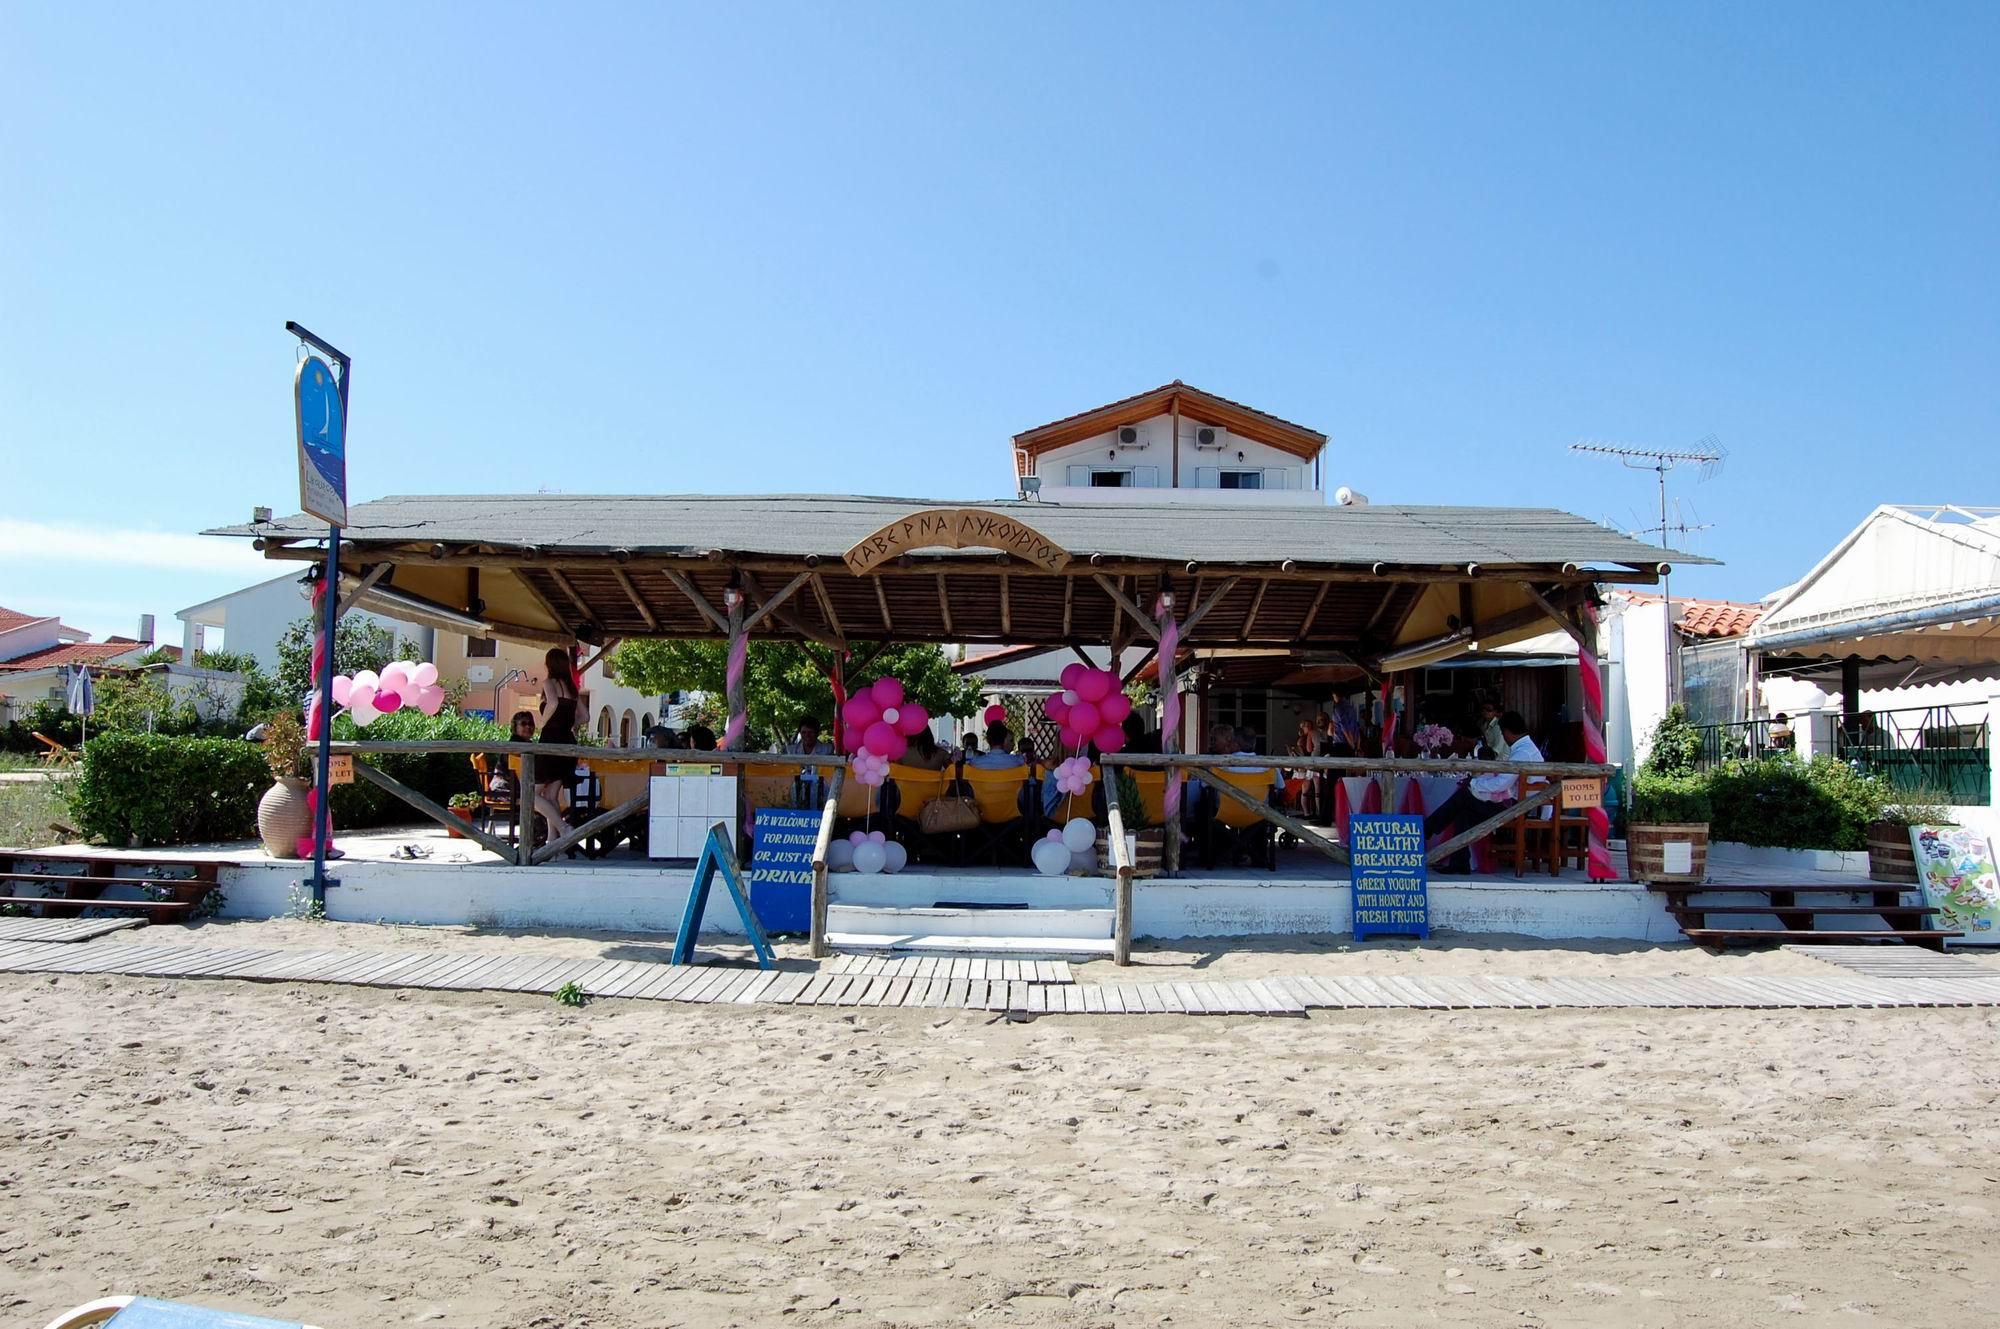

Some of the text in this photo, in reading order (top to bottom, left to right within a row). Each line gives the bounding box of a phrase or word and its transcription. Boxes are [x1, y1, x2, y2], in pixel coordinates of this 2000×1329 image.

[850, 515, 1064, 568] ΤΑΒΕΡΝΑ ΛΥΚΟΥΡΓΟΣ
[1563, 783, 1594, 791] ROOMS
[1584, 793, 1599, 801] LET
[755, 814, 821, 828] WE WELCOME YO
[1353, 821, 1420, 835] NATURAL
[763, 833, 782, 844] FOR
[1356, 836, 1420, 851] HEALTHY
[754, 850, 771, 861] OR
[771, 851, 802, 863] JUST
[1354, 853, 1424, 867] BREAKFAST
[1356, 877, 1421, 891] GREEK YOGURT
[1357, 894, 1425, 907] WITH HONEY AND
[1355, 910, 1425, 923] FRESH FRUITS
